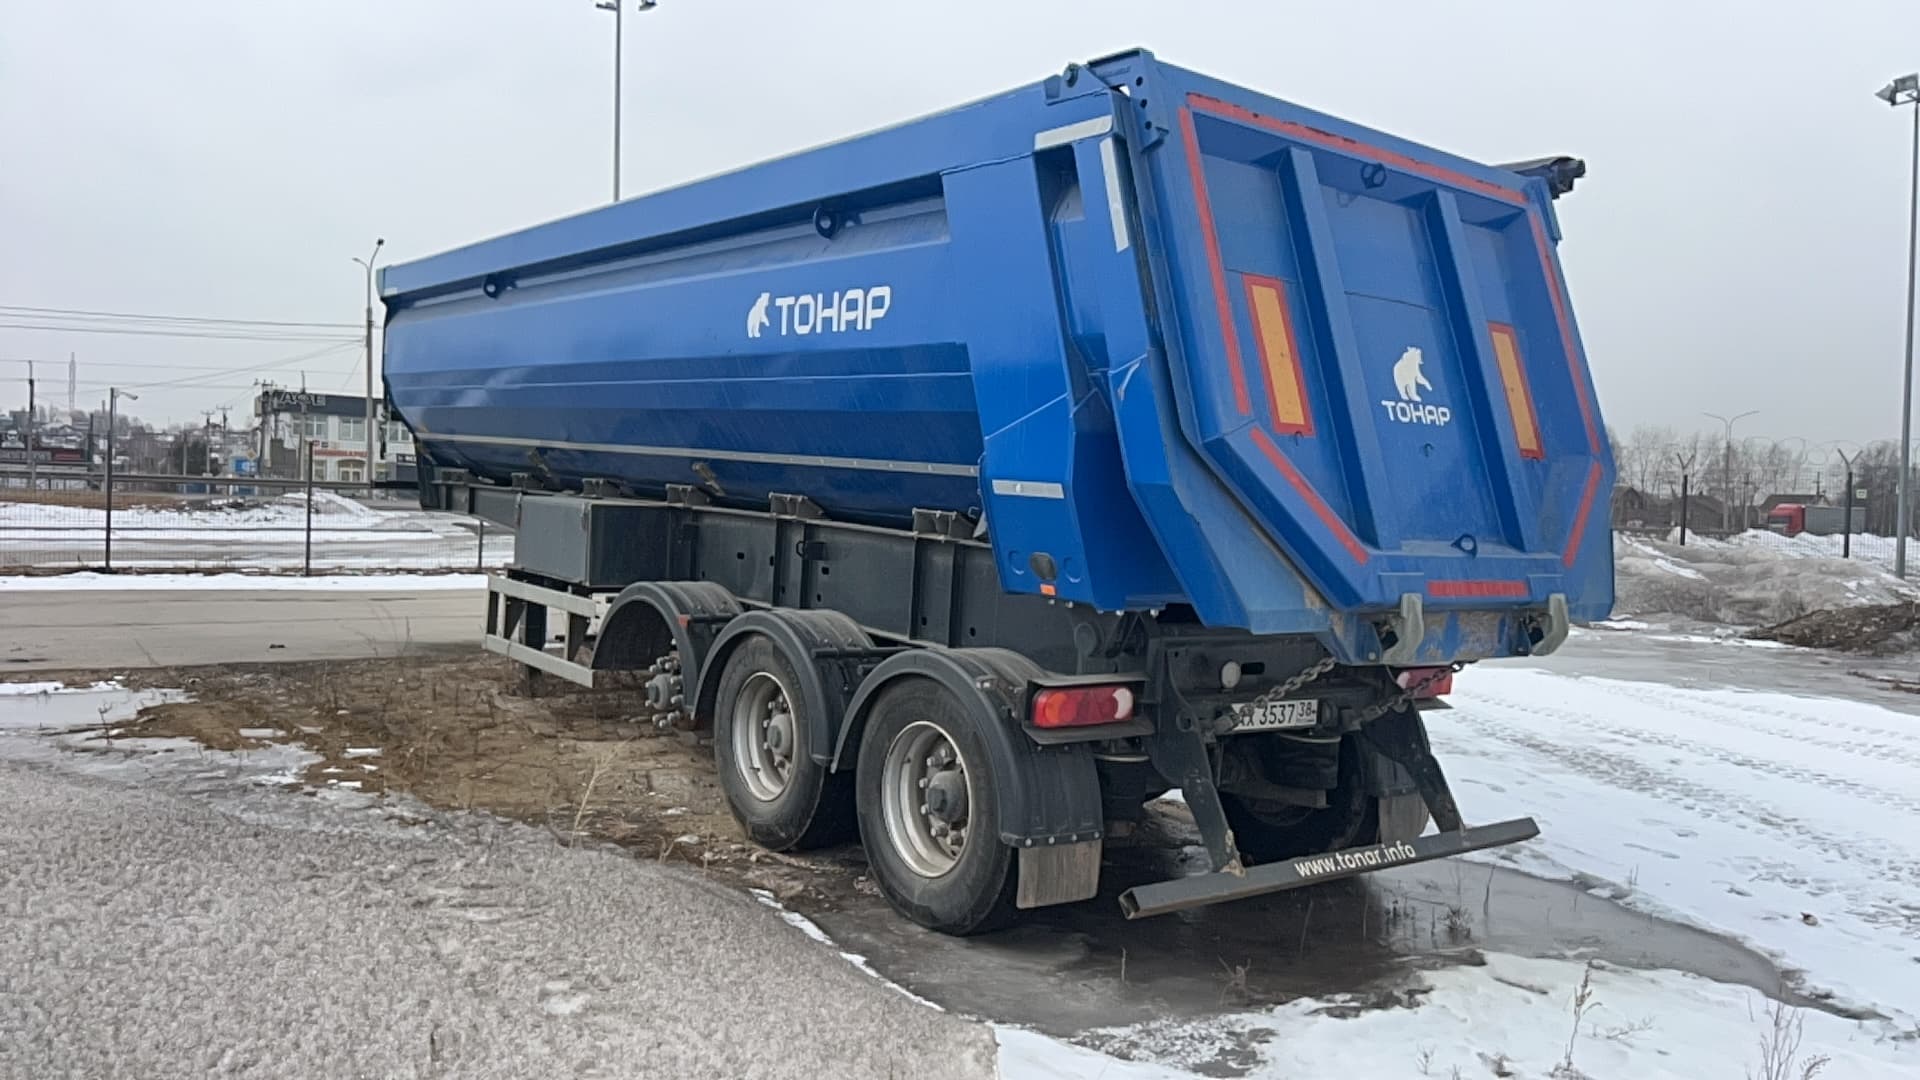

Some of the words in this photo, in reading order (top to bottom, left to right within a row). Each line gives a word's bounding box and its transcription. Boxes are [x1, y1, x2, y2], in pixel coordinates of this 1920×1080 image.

[775, 285, 891, 336] ТОНАР
[1381, 400, 1450, 426] ТОНАР
[1259, 703, 1295, 726] 3537
[1294, 840, 1417, 878] www.tonar.info
